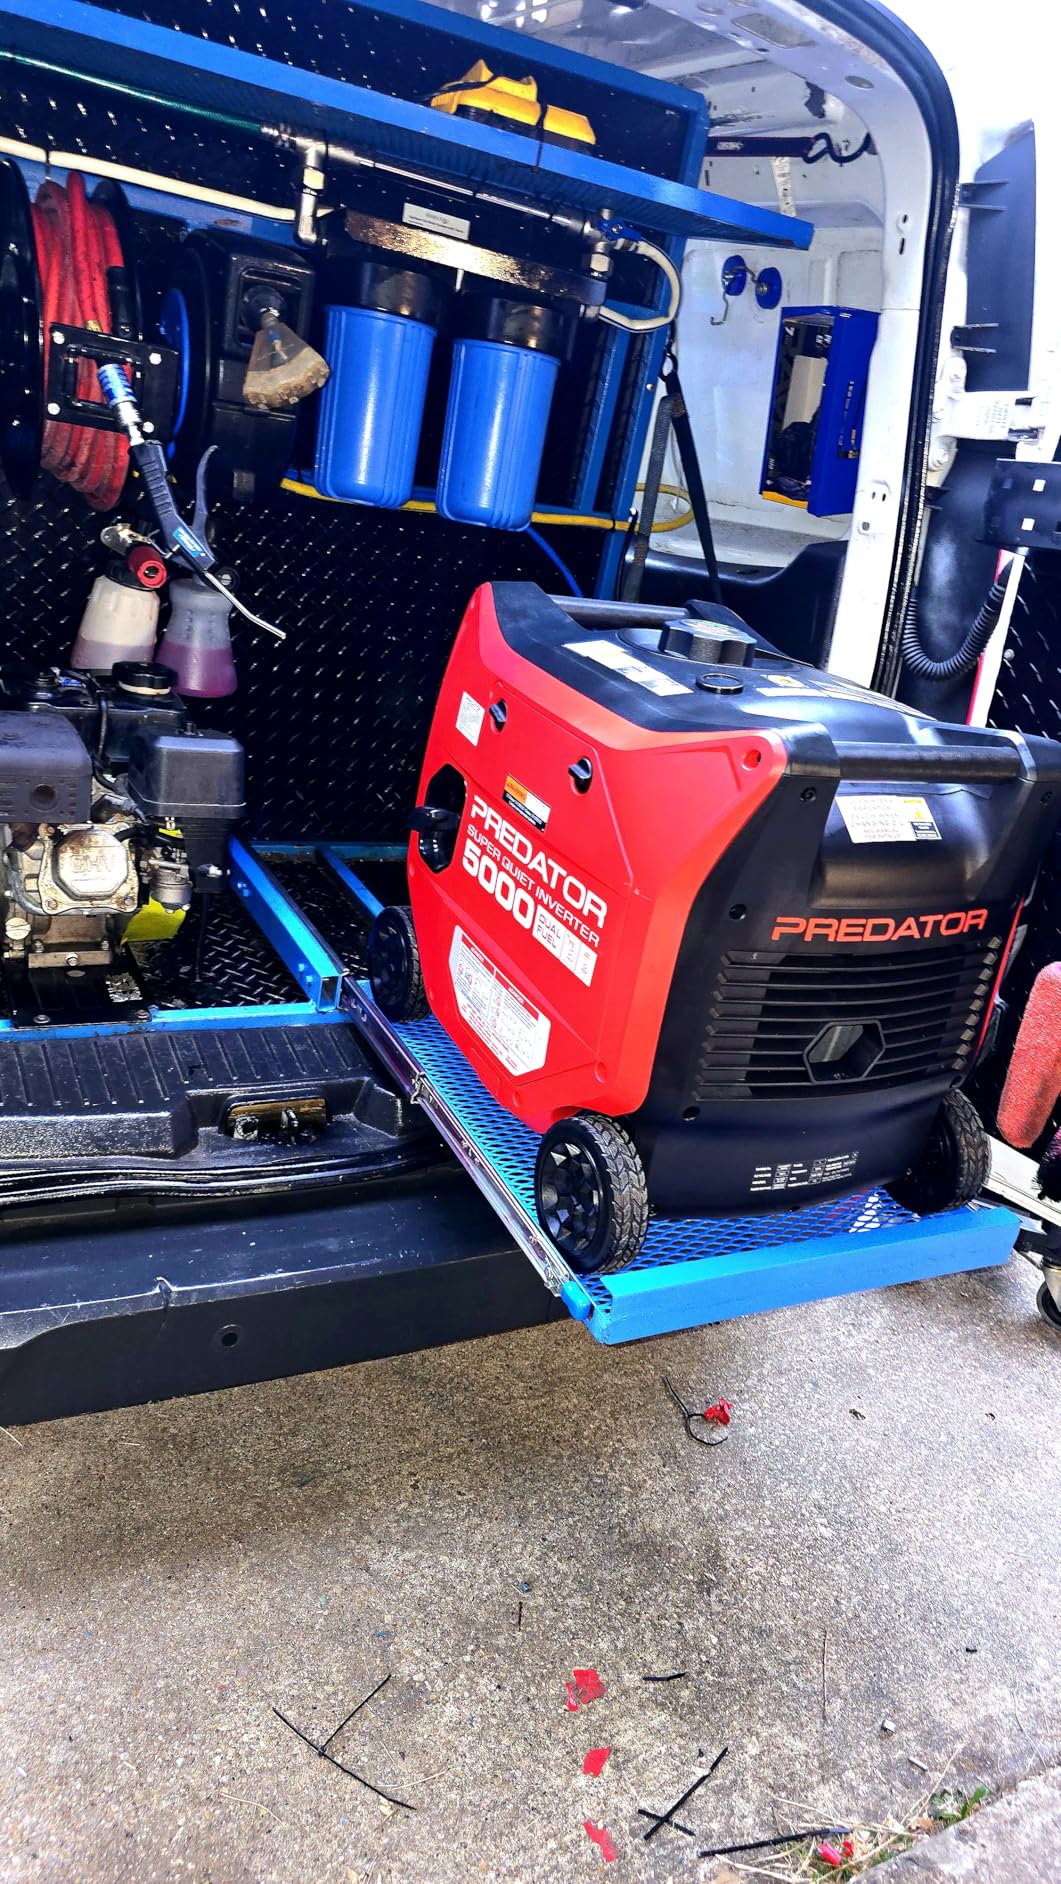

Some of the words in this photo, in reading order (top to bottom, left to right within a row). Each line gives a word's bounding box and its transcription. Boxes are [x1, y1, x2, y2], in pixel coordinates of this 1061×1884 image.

[462, 838, 535, 930] 5000
[467, 824, 501, 862] SUPER
[501, 855, 536, 891] QUIET
[535, 886, 600, 948] INVERTER
[471, 795, 607, 928] PREDATOR
[536, 924, 557, 949] FUEL
[539, 914, 561, 939] DUAL
[771, 908, 988, 942] PREDATOR
